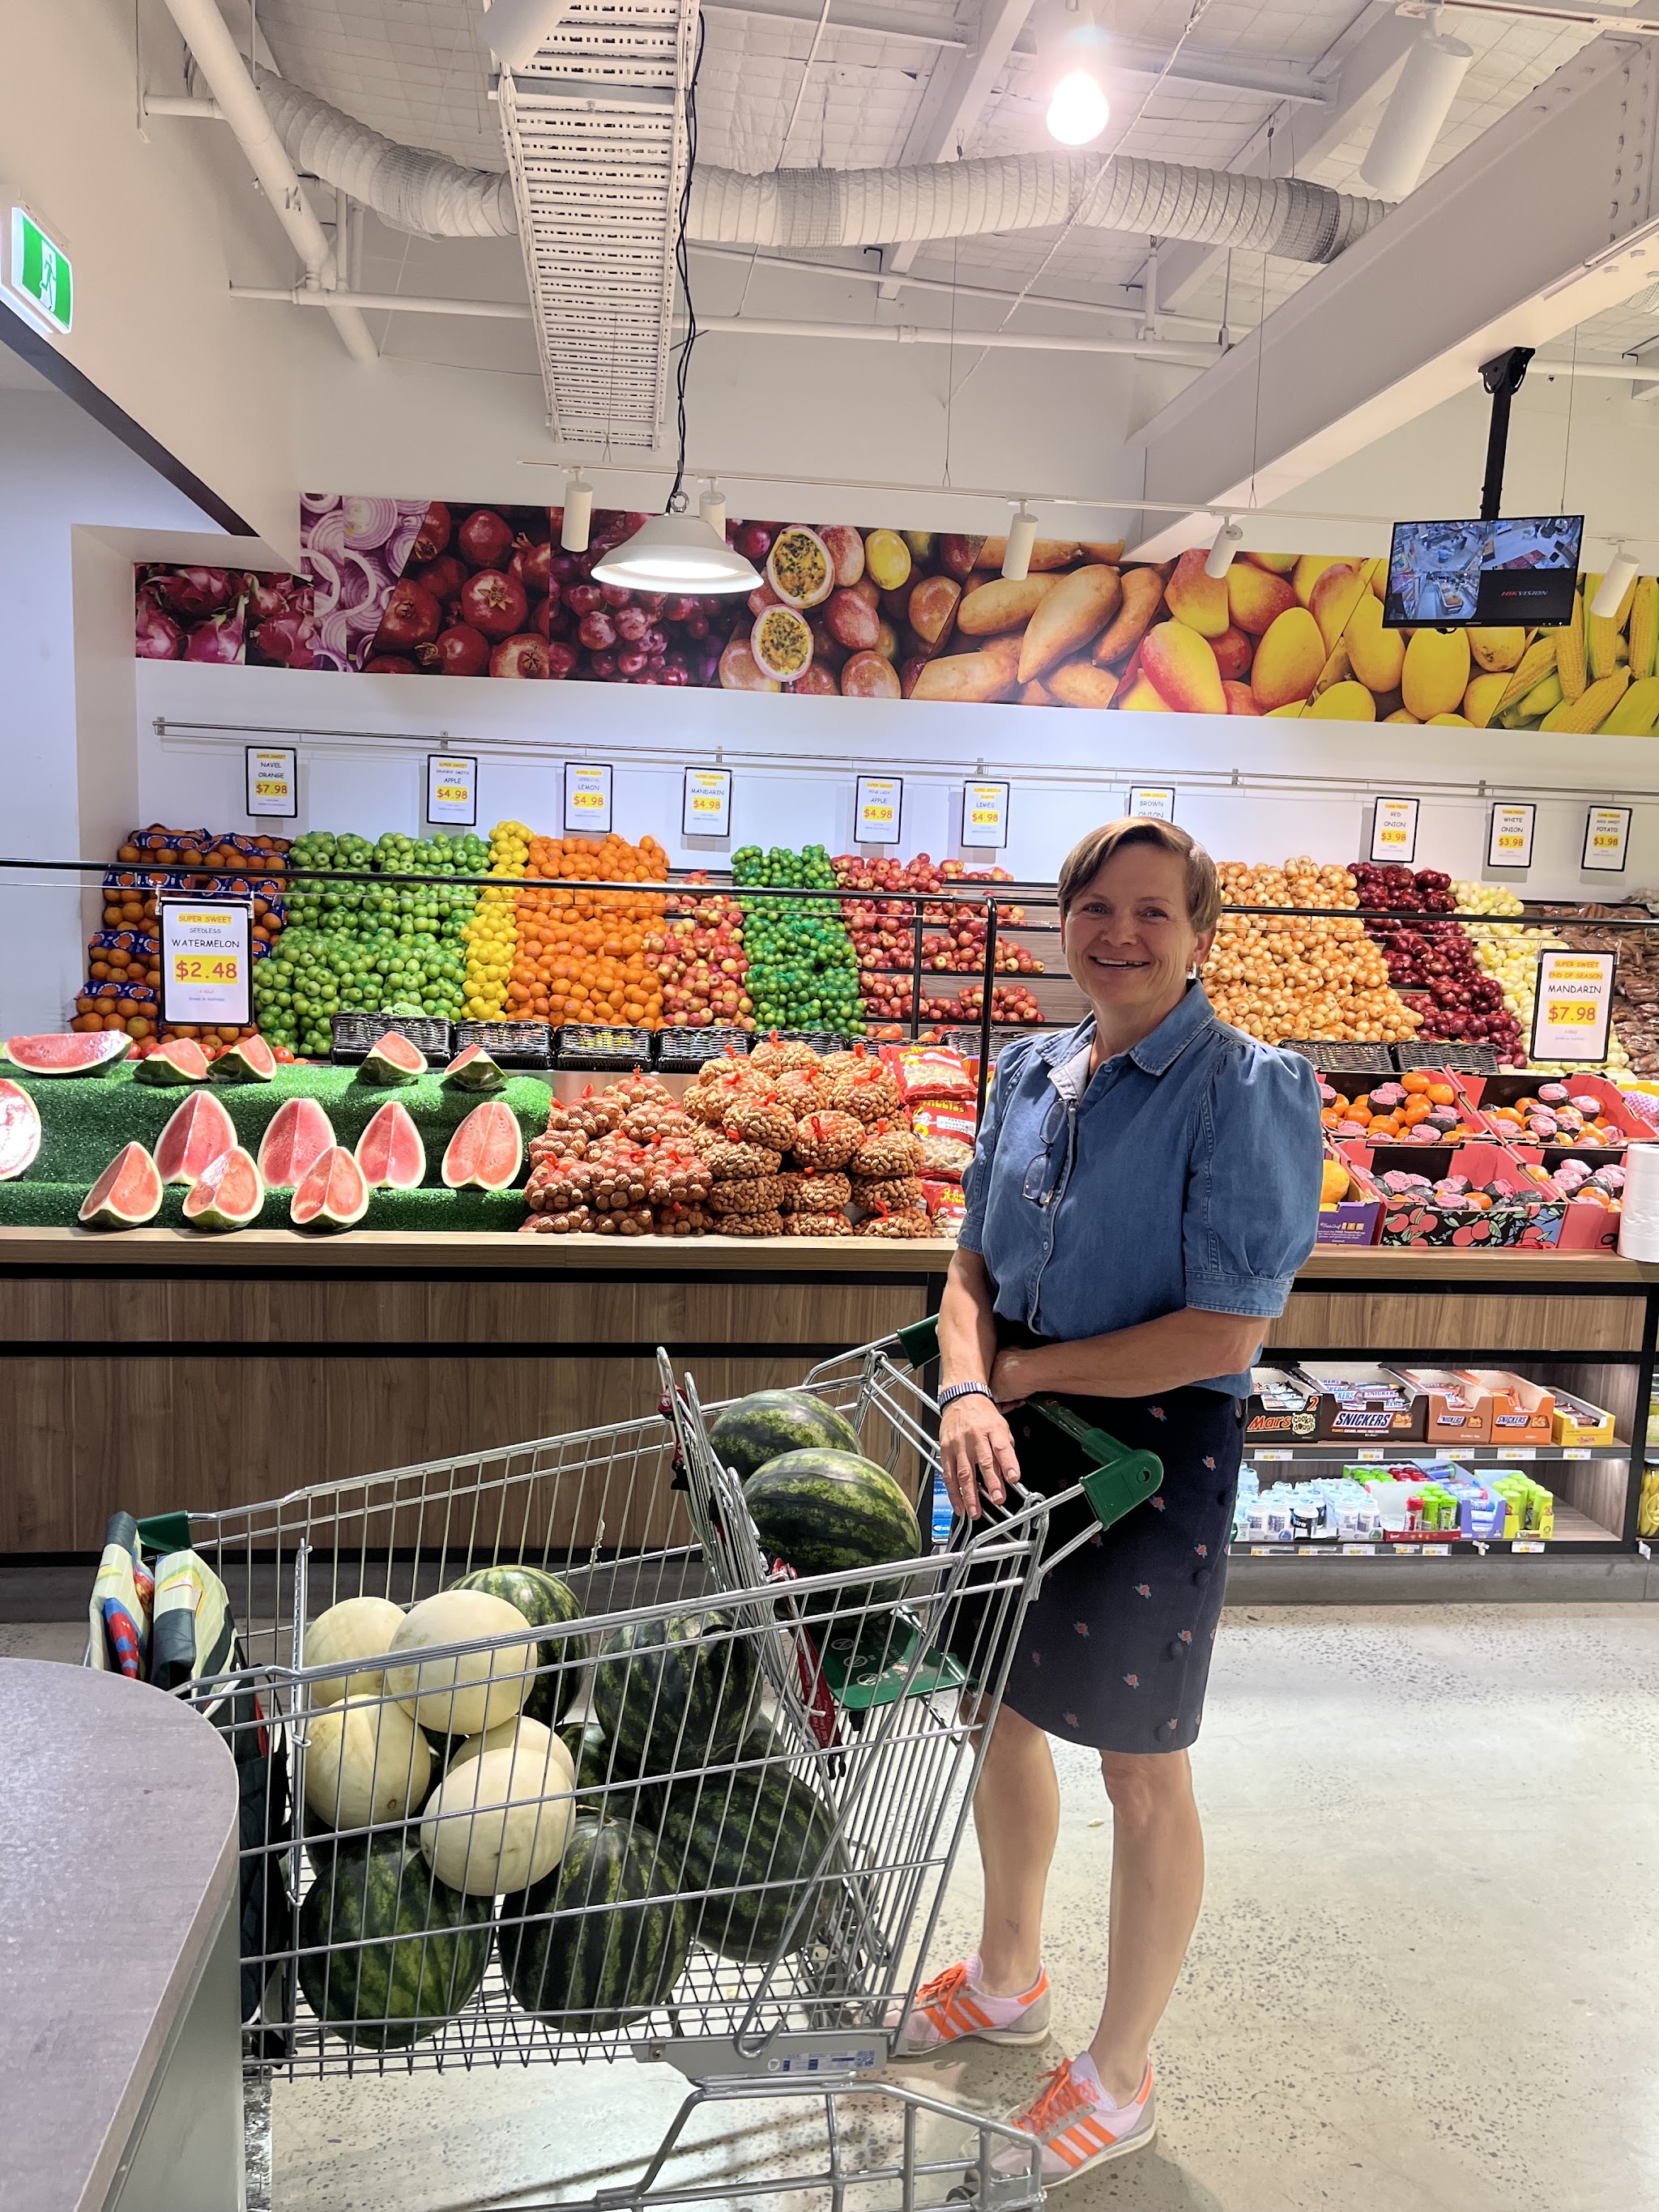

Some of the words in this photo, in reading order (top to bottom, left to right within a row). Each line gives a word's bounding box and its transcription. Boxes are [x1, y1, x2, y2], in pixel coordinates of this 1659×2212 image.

[256, 783, 288, 795] $7.98
[437, 788, 467, 799] $4.98
[574, 795, 603, 806] $4.98
[693, 799, 721, 809] $4.98
[864, 808, 893, 819] $4.98
[972, 812, 998, 822] $4.98
[1381, 832, 1406, 842] $3.98
[1499, 837, 1524, 846] $3.98
[1593, 837, 1618, 846] $3.98
[172, 940, 240, 948] WATERMELON
[176, 960, 237, 981] $2.48
[1548, 985, 1601, 994] MANDARIN
[1549, 1005, 1595, 1022] $7.98
[923, 1101, 965, 1113] Nibbles
[1307, 1396, 1319, 1411] 2
[1247, 1416, 1291, 1430] Mars
[1336, 1413, 1391, 1426] SNICKERS
[1294, 1422, 1315, 1431] dough
